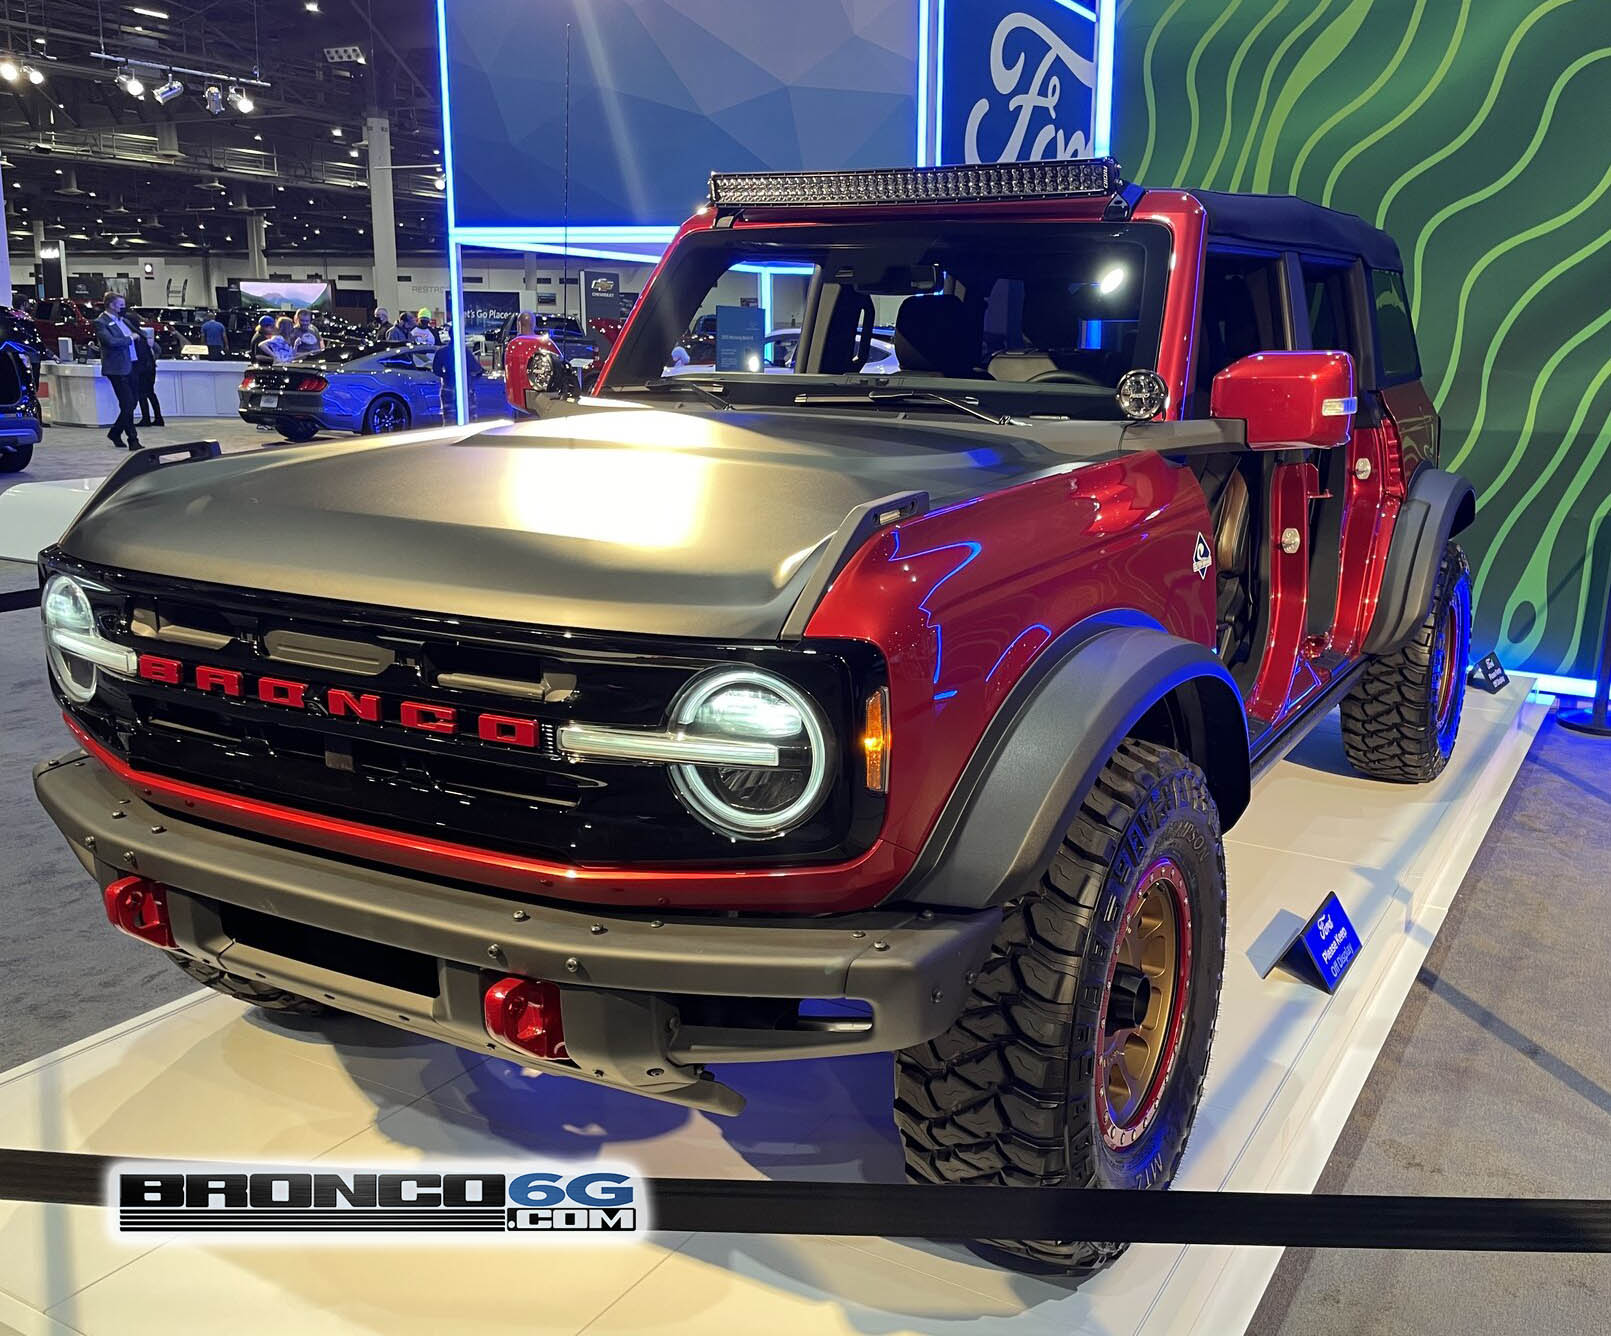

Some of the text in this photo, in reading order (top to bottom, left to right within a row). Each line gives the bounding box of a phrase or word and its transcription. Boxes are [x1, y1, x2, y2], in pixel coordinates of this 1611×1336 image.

[476, 309, 488, 319] Go
[138, 654, 540, 748] BRONCO
[1317, 913, 1334, 940] Ford
[1322, 926, 1348, 965] Please Keep
[1331, 943, 1355, 978] Off Display
